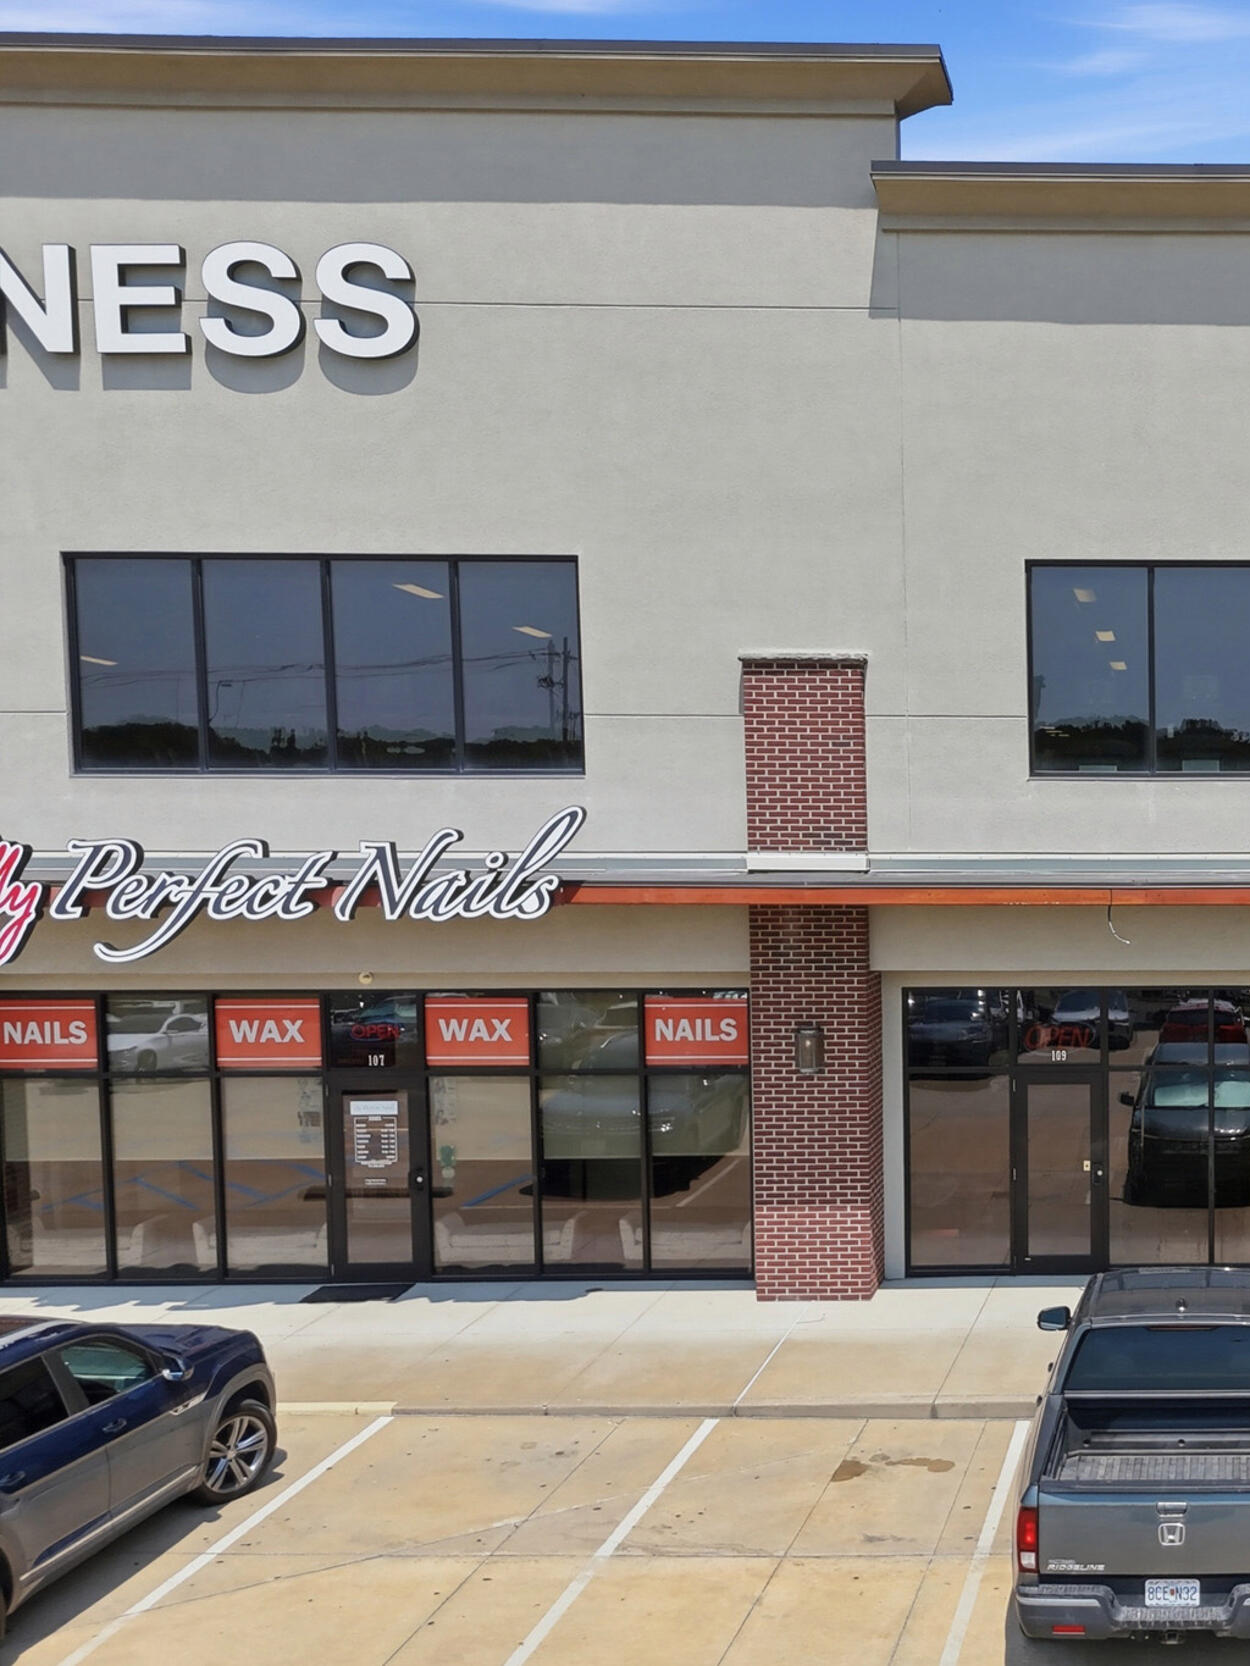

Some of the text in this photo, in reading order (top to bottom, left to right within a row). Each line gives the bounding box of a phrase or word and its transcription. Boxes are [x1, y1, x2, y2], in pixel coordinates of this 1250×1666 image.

[0, 239, 418, 360] NESS
[50, 838, 336, 963] Perfect
[334, 805, 586, 923] Nails
[3, 1020, 88, 1045] NAILS
[229, 1019, 304, 1043] WAX
[351, 1023, 400, 1040] OPEN
[438, 1018, 513, 1042] WAX
[655, 1018, 737, 1042] NAILS
[1024, 1023, 1091, 1050] OPEN
[368, 1053, 385, 1067] 107
[1051, 1050, 1067, 1062] 109
[1047, 1563, 1106, 1571] RIDGELINE
[1176, 1586, 1198, 1601] N32
